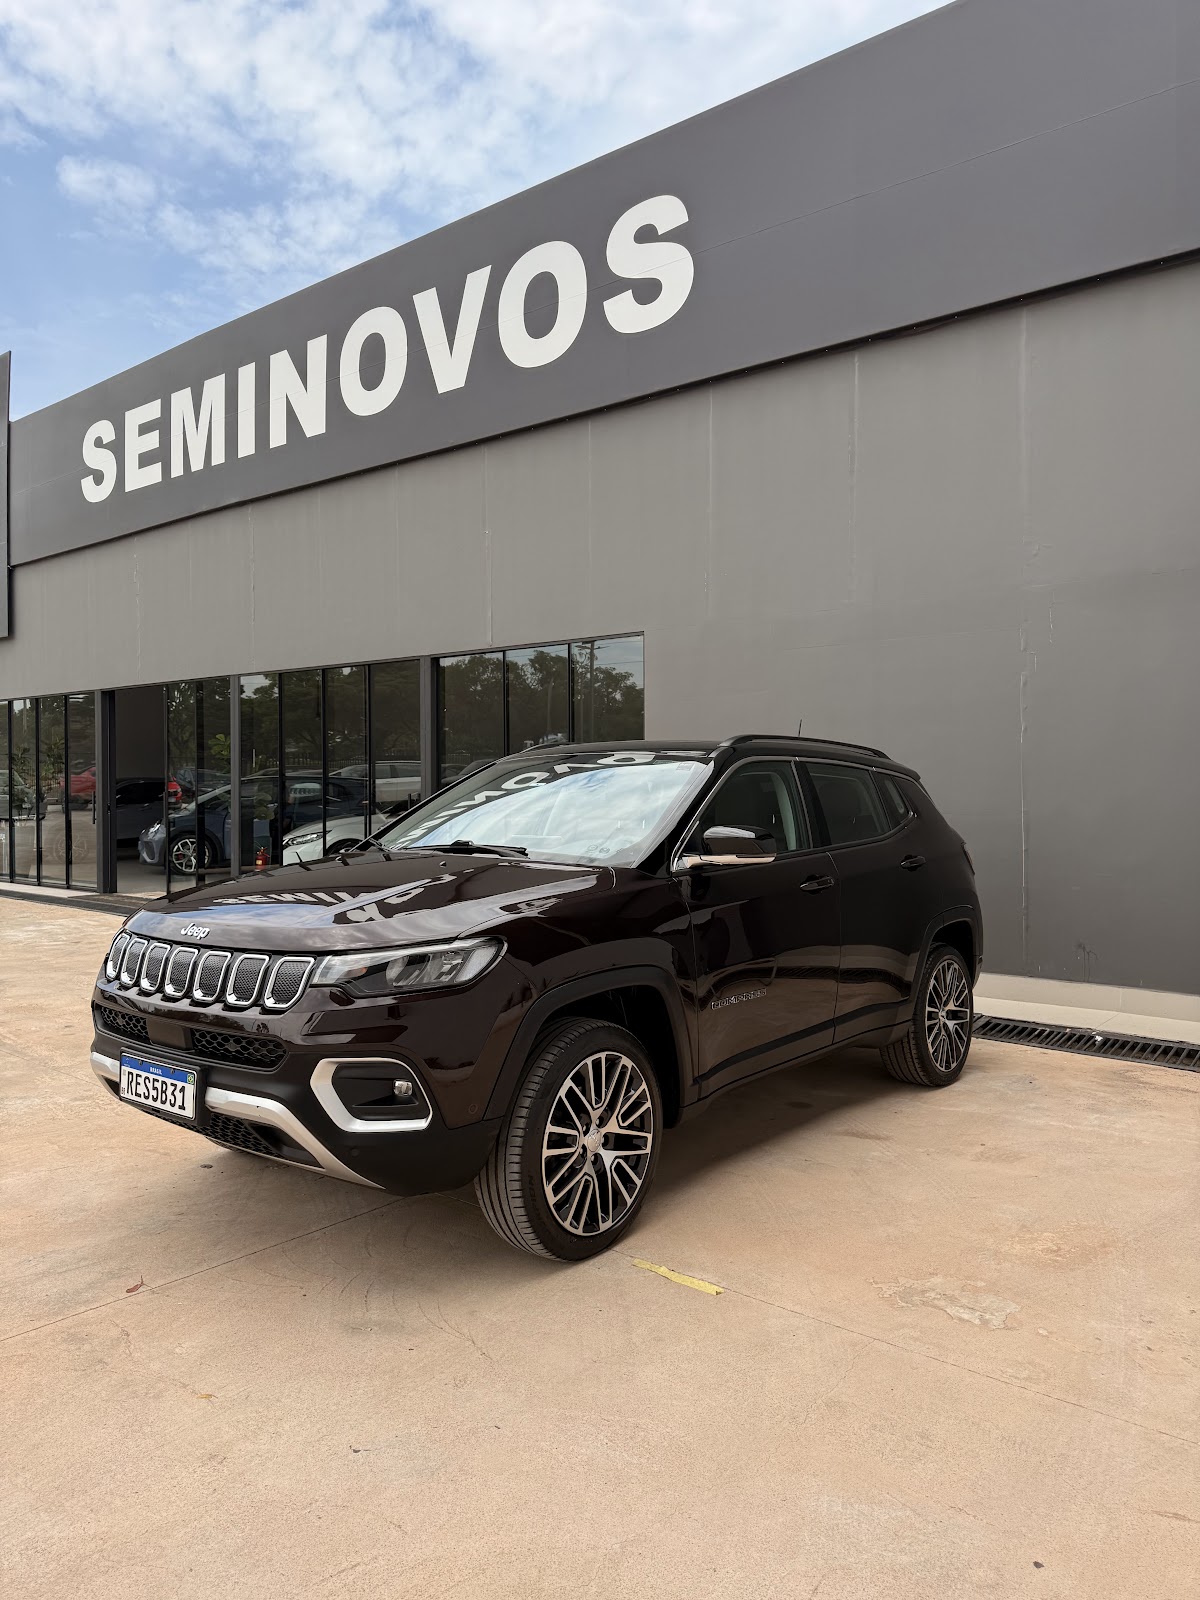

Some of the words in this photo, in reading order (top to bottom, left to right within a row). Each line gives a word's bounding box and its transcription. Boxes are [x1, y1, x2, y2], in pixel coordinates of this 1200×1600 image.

[80, 194, 694, 503] SEMINOVOS
[180, 922, 210, 940] Jeep
[149, 1066, 163, 1075] BRASIL
[126, 1071, 186, 1111] RES5B31
